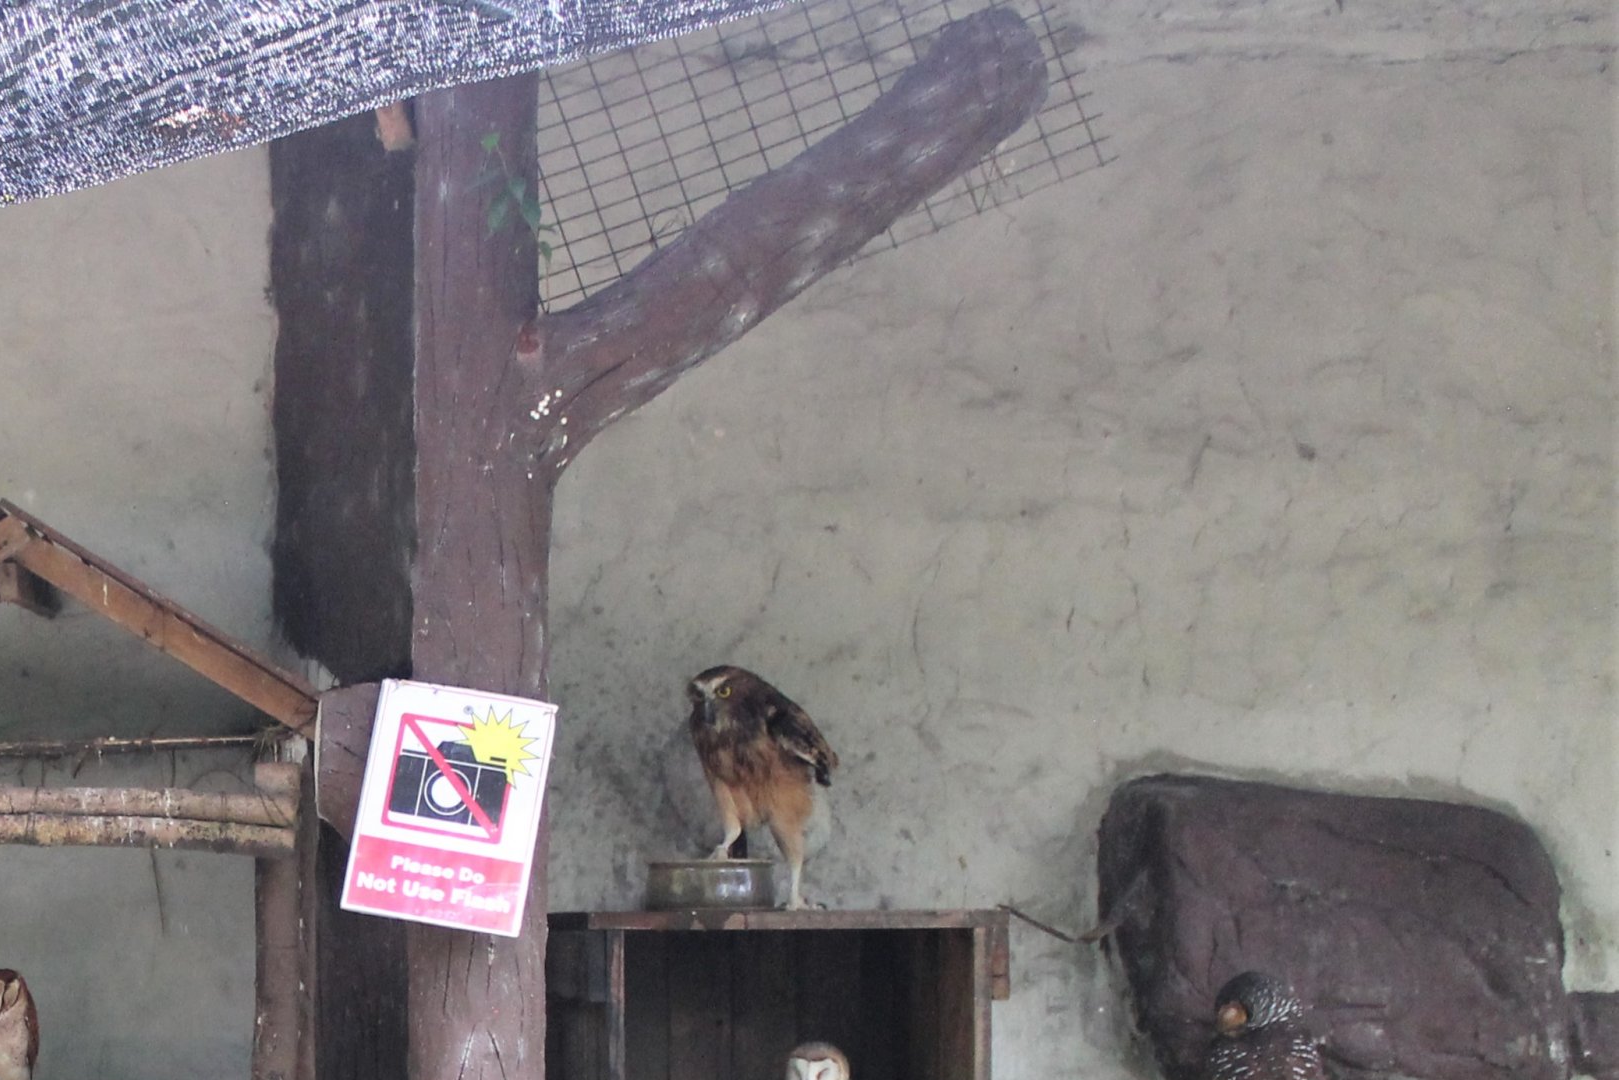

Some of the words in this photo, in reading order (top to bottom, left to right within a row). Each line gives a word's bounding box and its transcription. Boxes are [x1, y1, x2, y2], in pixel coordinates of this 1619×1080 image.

[391, 855, 454, 879] Please
[459, 867, 485, 884] Do
[357, 872, 396, 893] Not
[402, 880, 445, 902] Use
[450, 888, 511, 914] Flash
